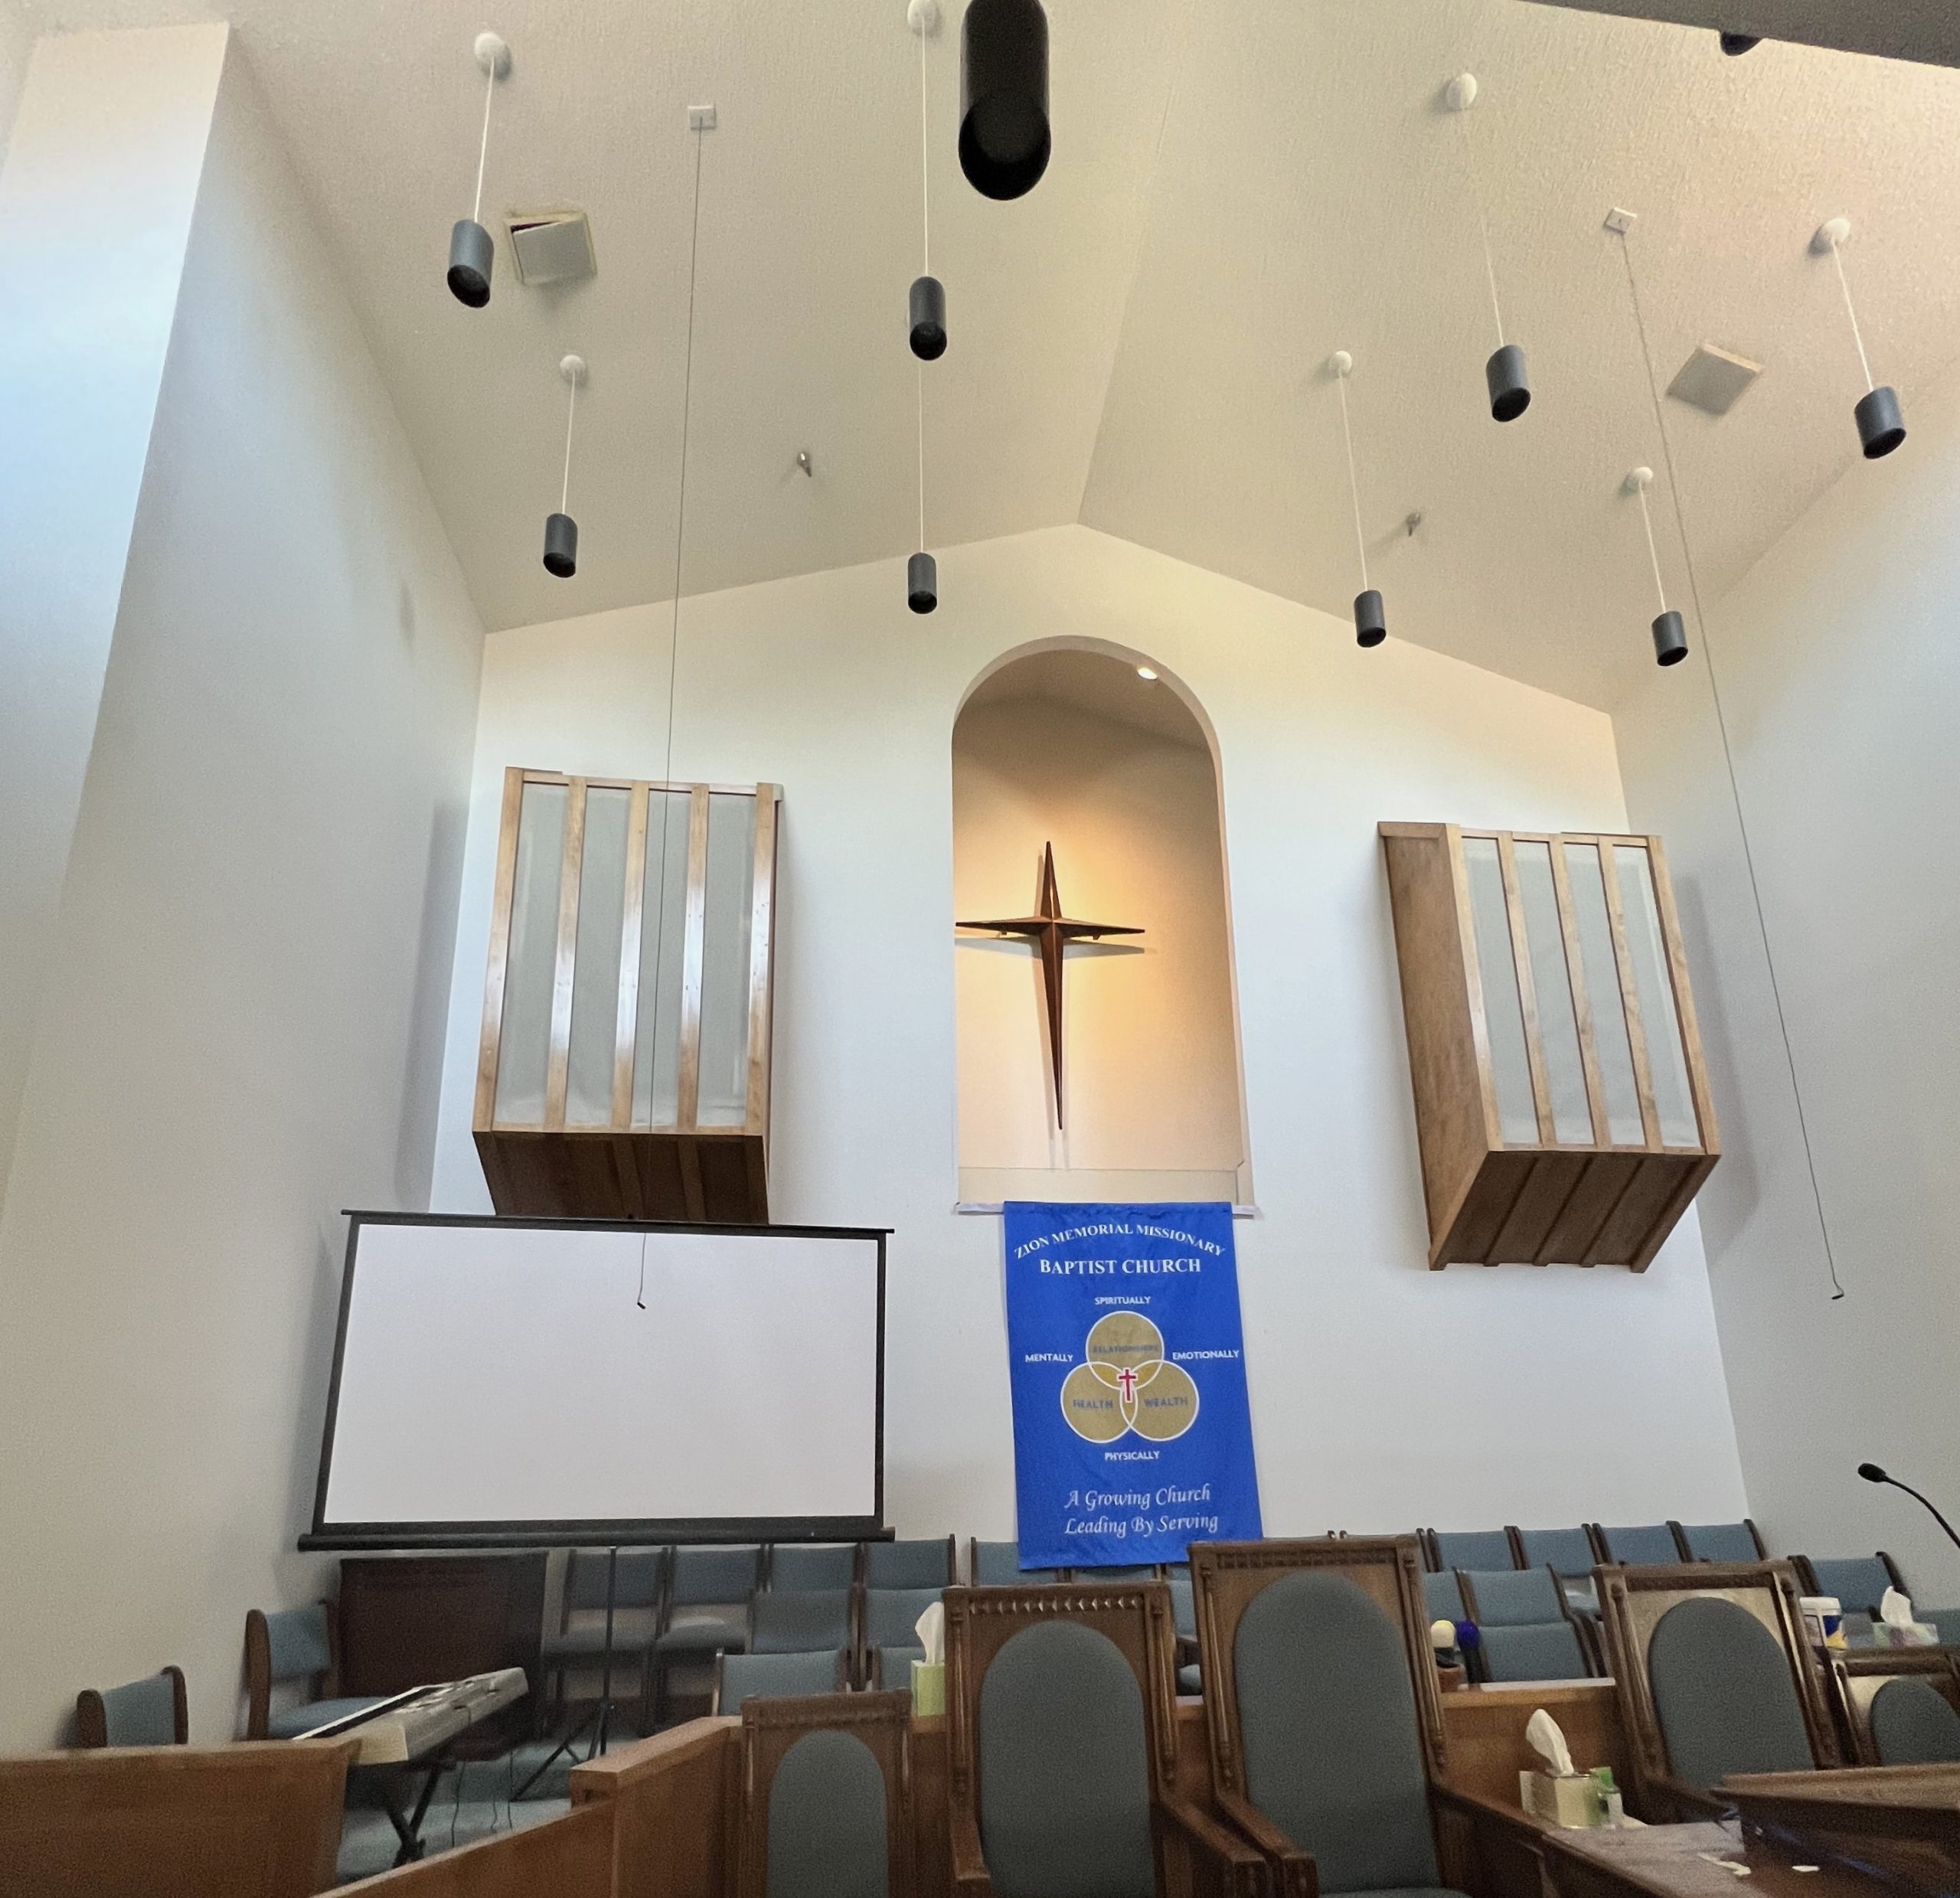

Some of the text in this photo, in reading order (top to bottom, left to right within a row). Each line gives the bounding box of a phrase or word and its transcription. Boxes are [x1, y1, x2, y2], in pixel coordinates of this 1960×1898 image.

[1014, 1224, 1225, 1259] ZION MEMORIAL MISSIONARY
[1040, 1258, 1201, 1275] BAPTIST CHURCH
[1094, 1296, 1151, 1305] SPIRITUALLY
[1025, 1354, 1073, 1362] MENTALLY
[1172, 1350, 1239, 1361] EMOTIONALLY
[1073, 1400, 1113, 1409] HEALTH
[1145, 1397, 1187, 1408] WEALTH
[1105, 1451, 1160, 1461] PHYSICALLY
[1064, 1483, 1210, 1511] A Growing Church
[1065, 1515, 1219, 1537] Leading By Serving
